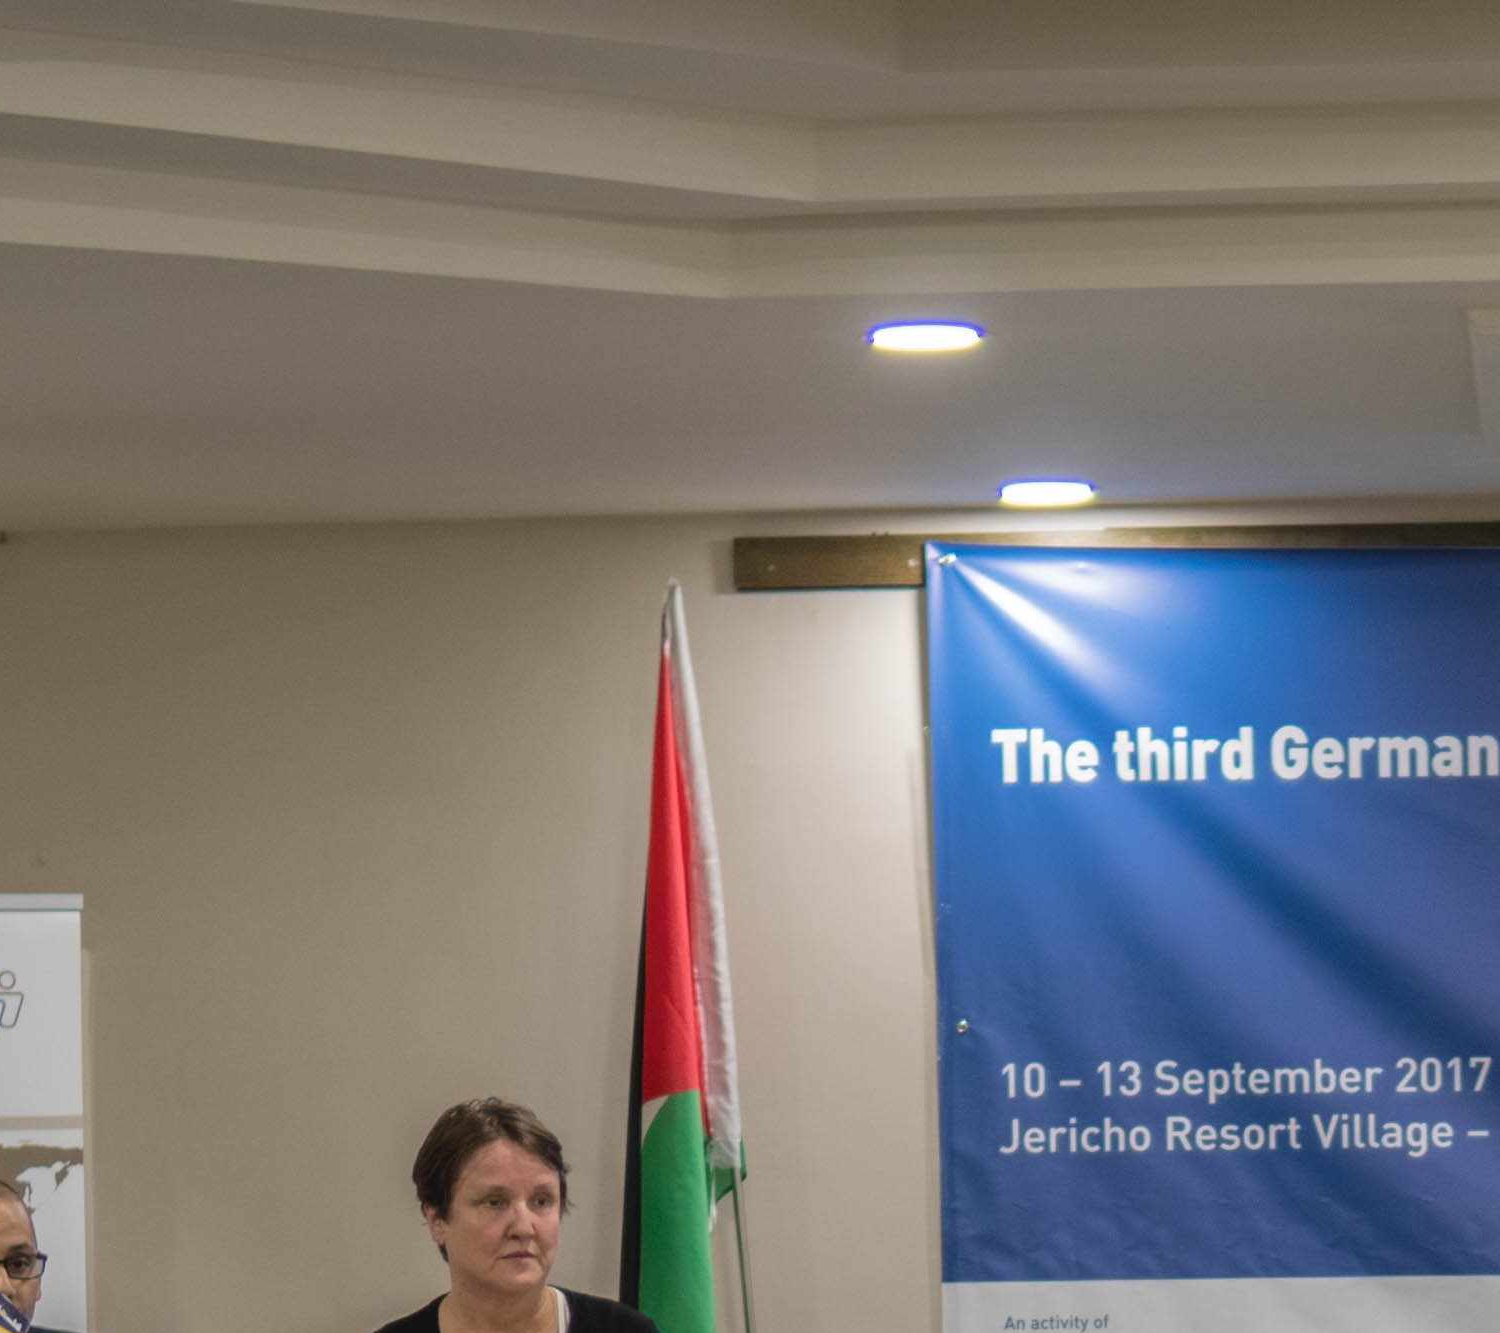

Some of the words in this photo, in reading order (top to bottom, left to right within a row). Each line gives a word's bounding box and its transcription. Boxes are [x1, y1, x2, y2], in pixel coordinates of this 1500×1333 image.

[990, 727, 1100, 784] The
[1112, 725, 1254, 782] third
[1270, 724, 1499, 782] German
[1001, 1062, 1046, 1099] 10
[1097, 1060, 1142, 1097] 13
[1154, 1057, 1384, 1105] September
[1394, 1056, 1492, 1095] 2017
[999, 1116, 1152, 1155] Jericho
[1165, 1115, 1302, 1152] Resort
[1312, 1113, 1455, 1158] Village
[1003, 1315, 1026, 1331] An
[1029, 1315, 1089, 1333] activity
[1092, 1313, 1110, 1330] of
